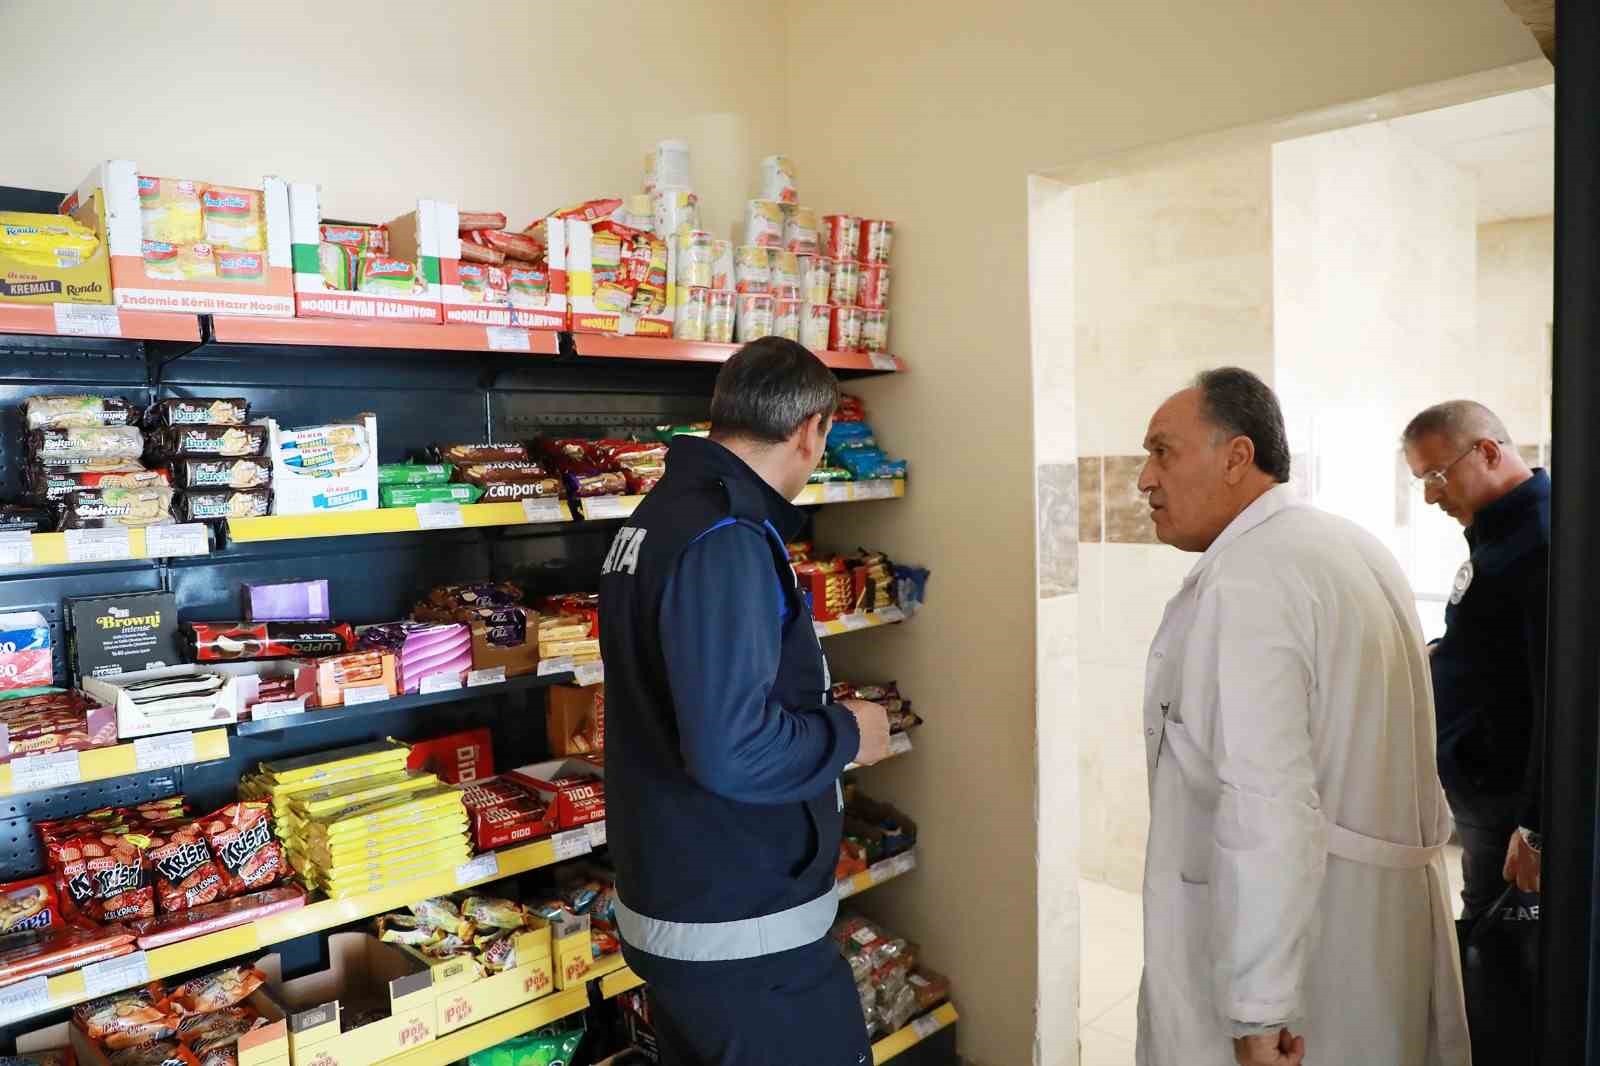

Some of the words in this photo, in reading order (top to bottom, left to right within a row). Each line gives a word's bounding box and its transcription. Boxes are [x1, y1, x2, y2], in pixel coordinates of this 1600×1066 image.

[10, 281, 55, 295] KREMALI
[66, 281, 102, 296] Rondo
[489, 482, 544, 499] canpare
